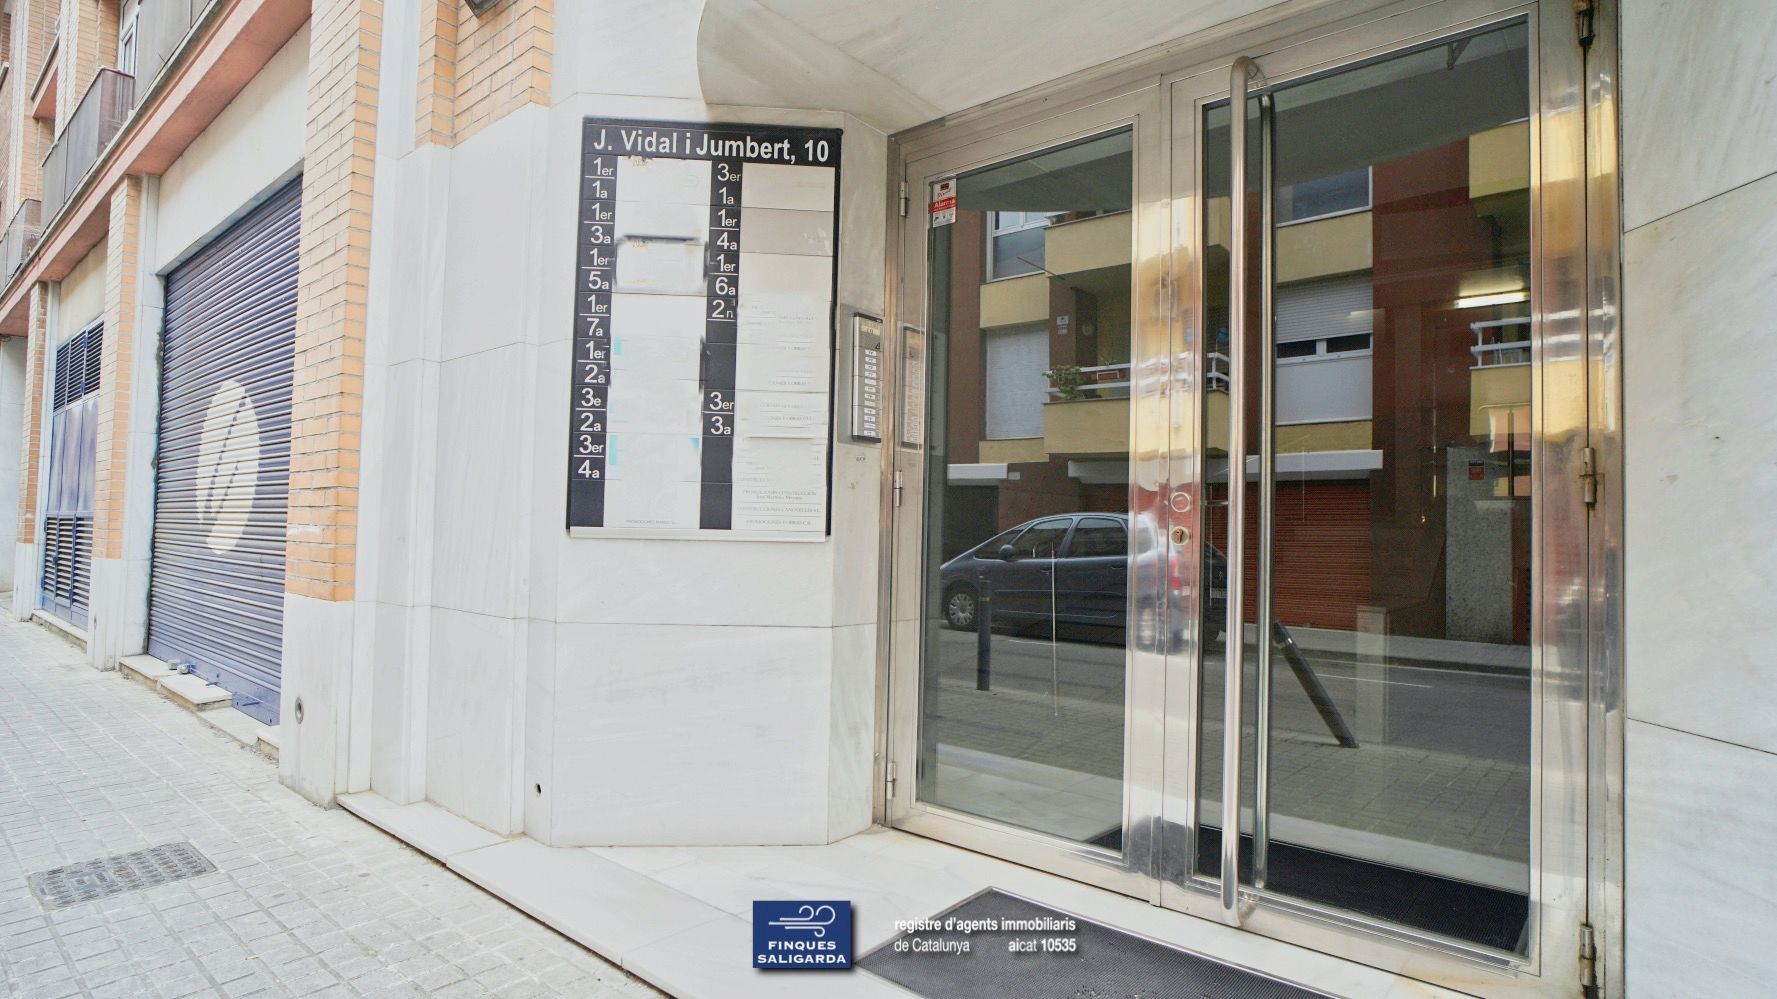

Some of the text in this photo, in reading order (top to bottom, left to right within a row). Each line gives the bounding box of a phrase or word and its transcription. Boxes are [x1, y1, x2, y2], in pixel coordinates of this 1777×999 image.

[594, 129, 829, 164] J. Vidal i Jumbert, 10
[593, 157, 613, 176] 1er
[717, 164, 741, 182] 3er
[592, 181, 608, 199] 1a
[719, 187, 734, 205] 1a
[591, 203, 612, 221] 1er
[718, 209, 737, 227] 1er
[590, 226, 611, 244] 3a
[717, 232, 738, 250] 4a
[590, 248, 610, 266] 1er
[717, 254, 736, 272] 1er
[588, 271, 609, 290] 5a
[715, 277, 736, 295] 6a
[587, 295, 608, 314] 1er
[712, 300, 734, 318] 2n
[587, 318, 603, 337] 7a
[585, 341, 605, 360] 1er
[584, 364, 606, 384] 2a
[581, 387, 601, 407] 3e
[709, 391, 735, 411] 3er
[580, 412, 601, 432] 2a
[710, 416, 731, 435] 3a
[579, 435, 604, 454] 3er
[577, 460, 600, 479] 4a
